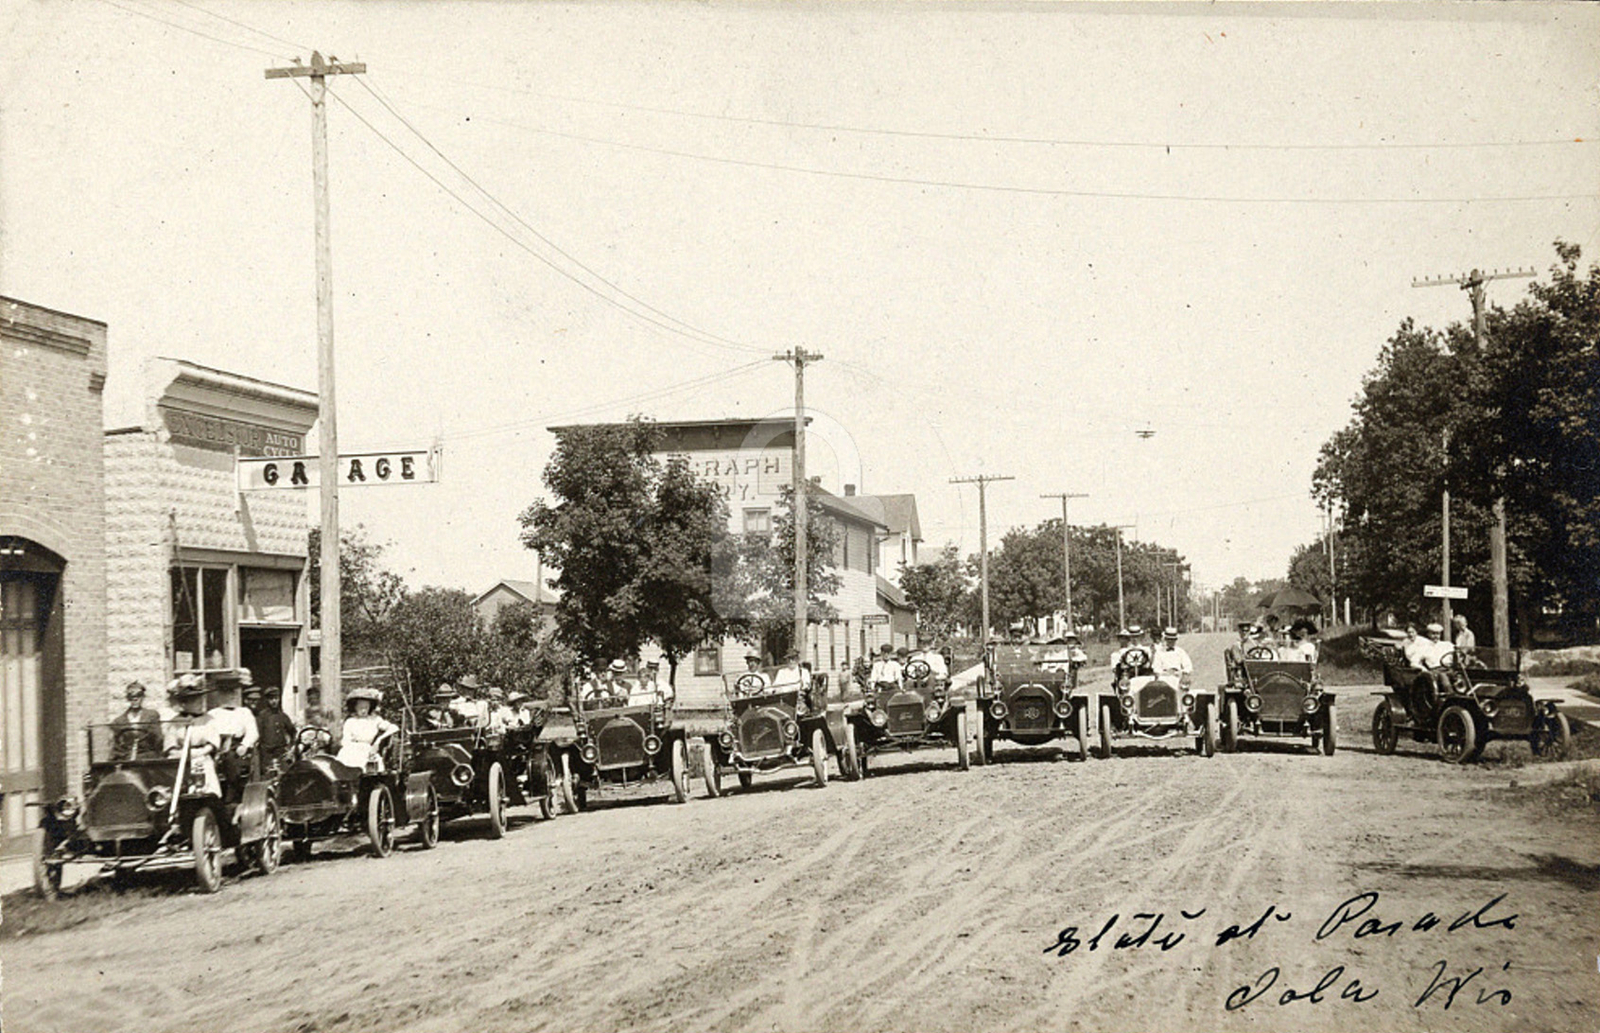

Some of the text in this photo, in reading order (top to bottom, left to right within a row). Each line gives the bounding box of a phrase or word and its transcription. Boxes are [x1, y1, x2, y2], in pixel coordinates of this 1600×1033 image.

[265, 432, 298, 448] AUTO
[262, 456, 416, 485] GAAGE
[1315, 891, 1519, 940] Parade
